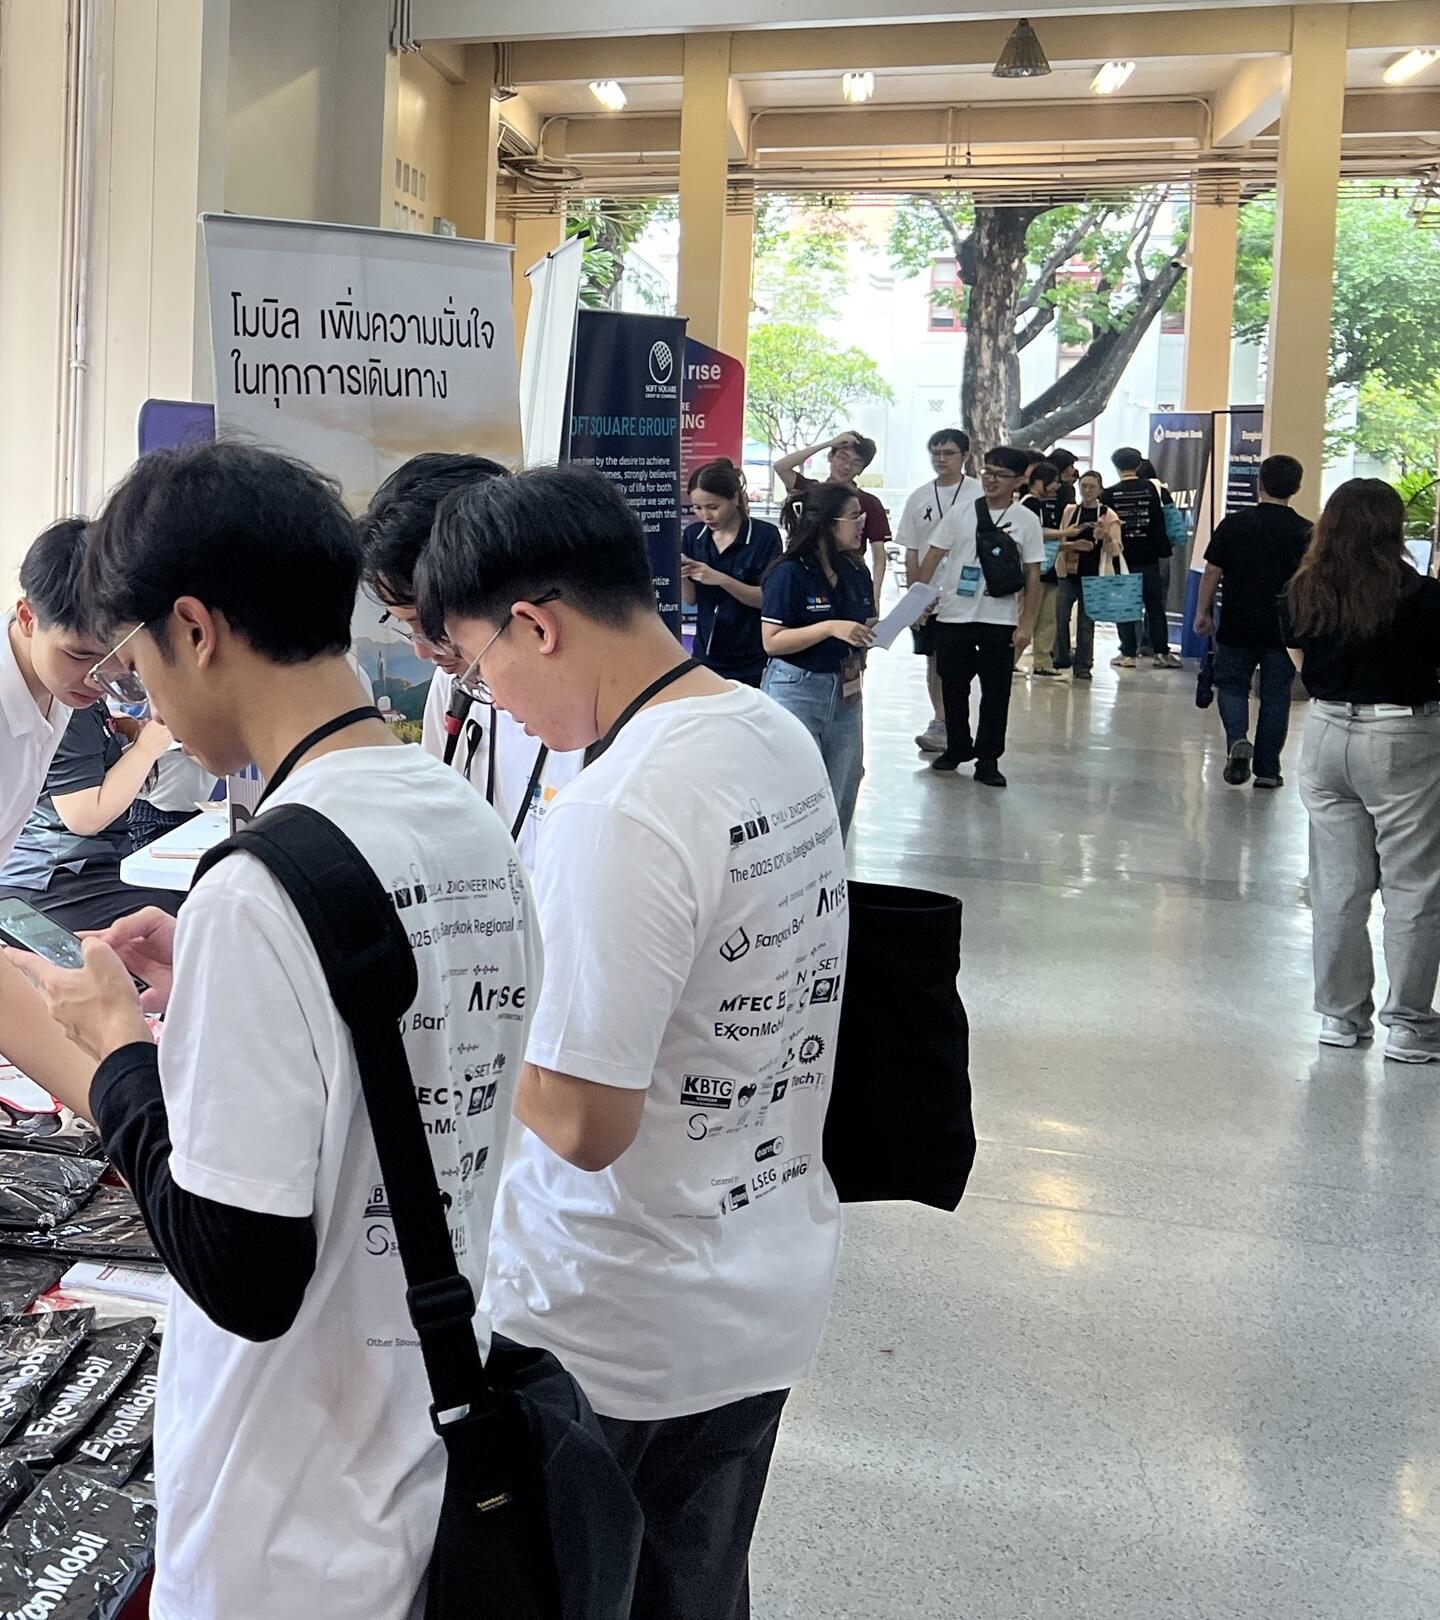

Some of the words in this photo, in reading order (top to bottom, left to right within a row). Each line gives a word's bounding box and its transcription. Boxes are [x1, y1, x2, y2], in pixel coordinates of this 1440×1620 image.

[231, 291, 301, 340] โมบิล
[320, 288, 495, 350] เพิ่มความมั่นใจ
[231, 349, 447, 409] ในทุกการเดินทาง
[688, 364, 721, 381] rise
[645, 385, 657, 393] SOFT
[658, 385, 677, 393] SQUARE
[571, 415, 589, 436] OFT
[590, 416, 637, 438] SQUARE
[638, 417, 677, 437] GROUP
[681, 413, 705, 429] ING
[596, 456, 604, 467] by
[606, 456, 618, 465] the
[619, 456, 638, 465] desire
[639, 457, 645, 465] to
[646, 456, 670, 465] achieve
[601, 471, 623, 481] omes,
[624, 470, 648, 481] strongly
[646, 483, 656, 492] for
[657, 483, 672, 492] both
[641, 511, 663, 520] growth
[664, 510, 677, 518] that
[643, 523, 660, 532] alued
[659, 603, 679, 612] future
[730, 869, 749, 884] The
[750, 858, 774, 878] 2025
[409, 930, 432, 949] 025
[817, 957, 839, 971] SET
[719, 995, 773, 1012] MFEC
[714, 1016, 785, 1041] ExxonMo
[417, 1086, 448, 1105] EC
[683, 1076, 733, 1097] KBTG
[751, 1168, 777, 1192] LSEG
[781, 1163, 808, 1185] KPMG
[367, 1336, 393, 1347] Other
[24, 1355, 113, 1437] ExxonMobil
[6, 1530, 109, 1620] onMobil
